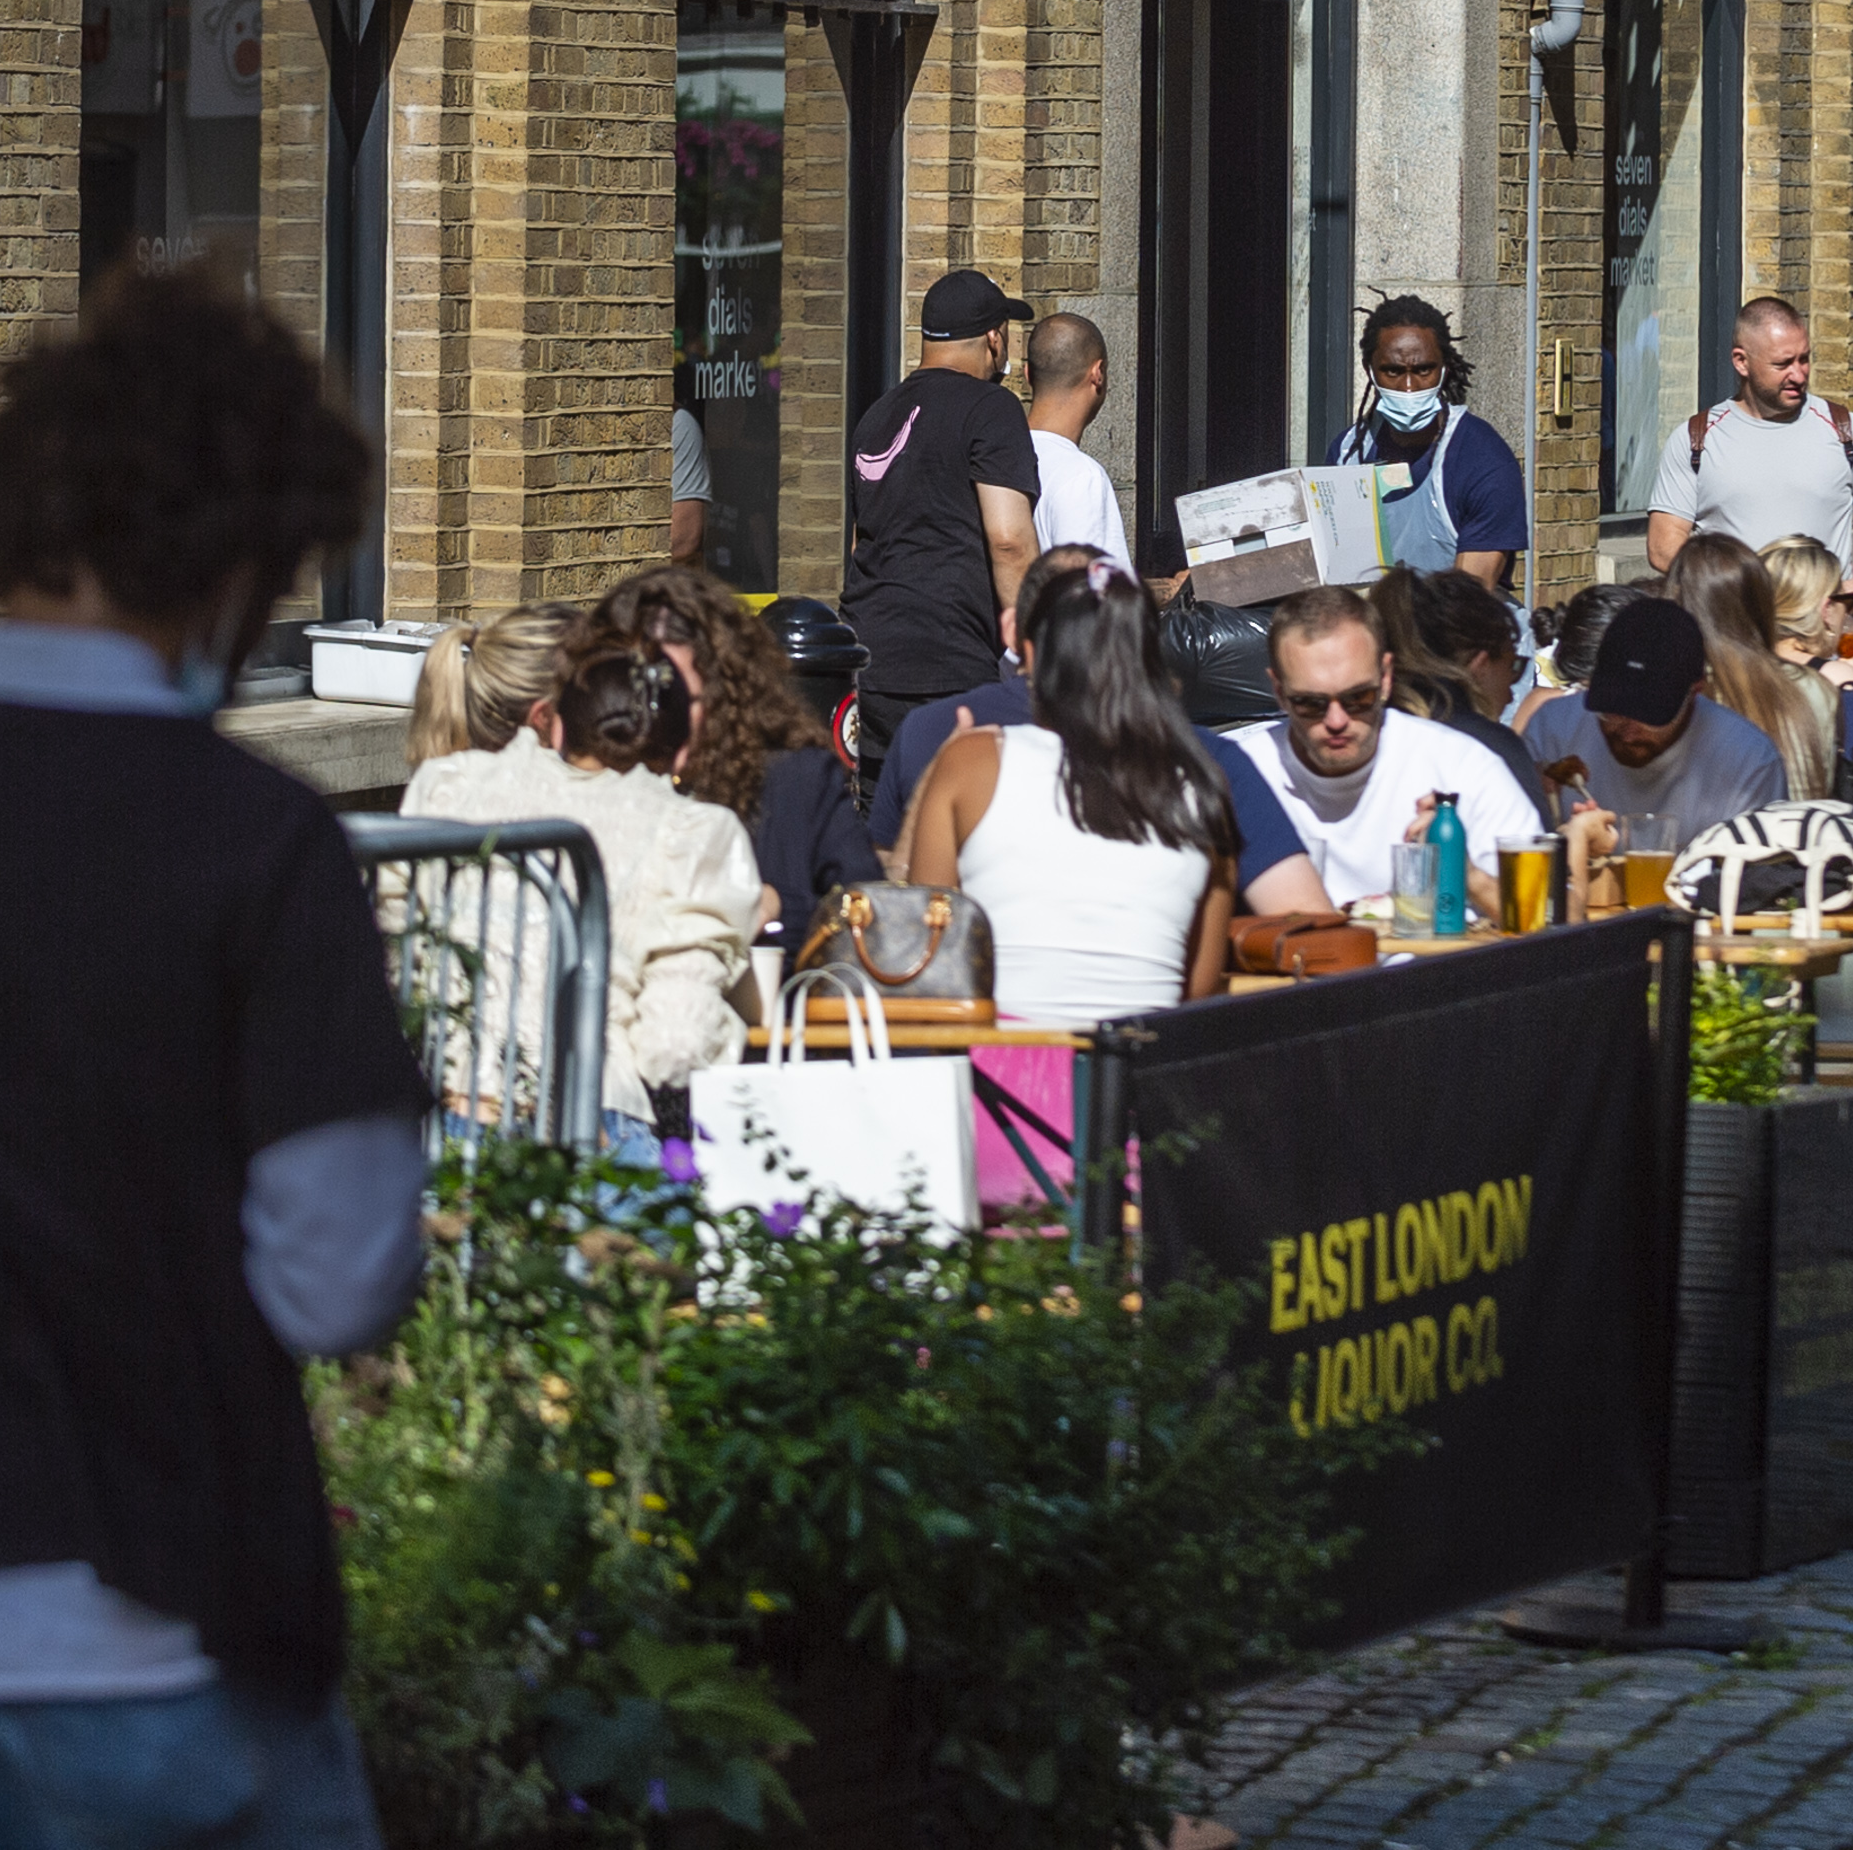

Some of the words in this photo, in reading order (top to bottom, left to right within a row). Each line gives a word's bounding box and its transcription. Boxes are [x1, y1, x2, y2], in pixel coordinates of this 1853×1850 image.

[1615, 154, 1652, 185] seven
[1619, 196, 1647, 237] dials
[1610, 248, 1654, 286] market
[708, 284, 753, 336] dials
[694, 351, 759, 399] marke
[1268, 1217, 1372, 1334] EAST
[1374, 1174, 1534, 1305] LONDON
[1289, 1315, 1439, 1439] LIQUOR
